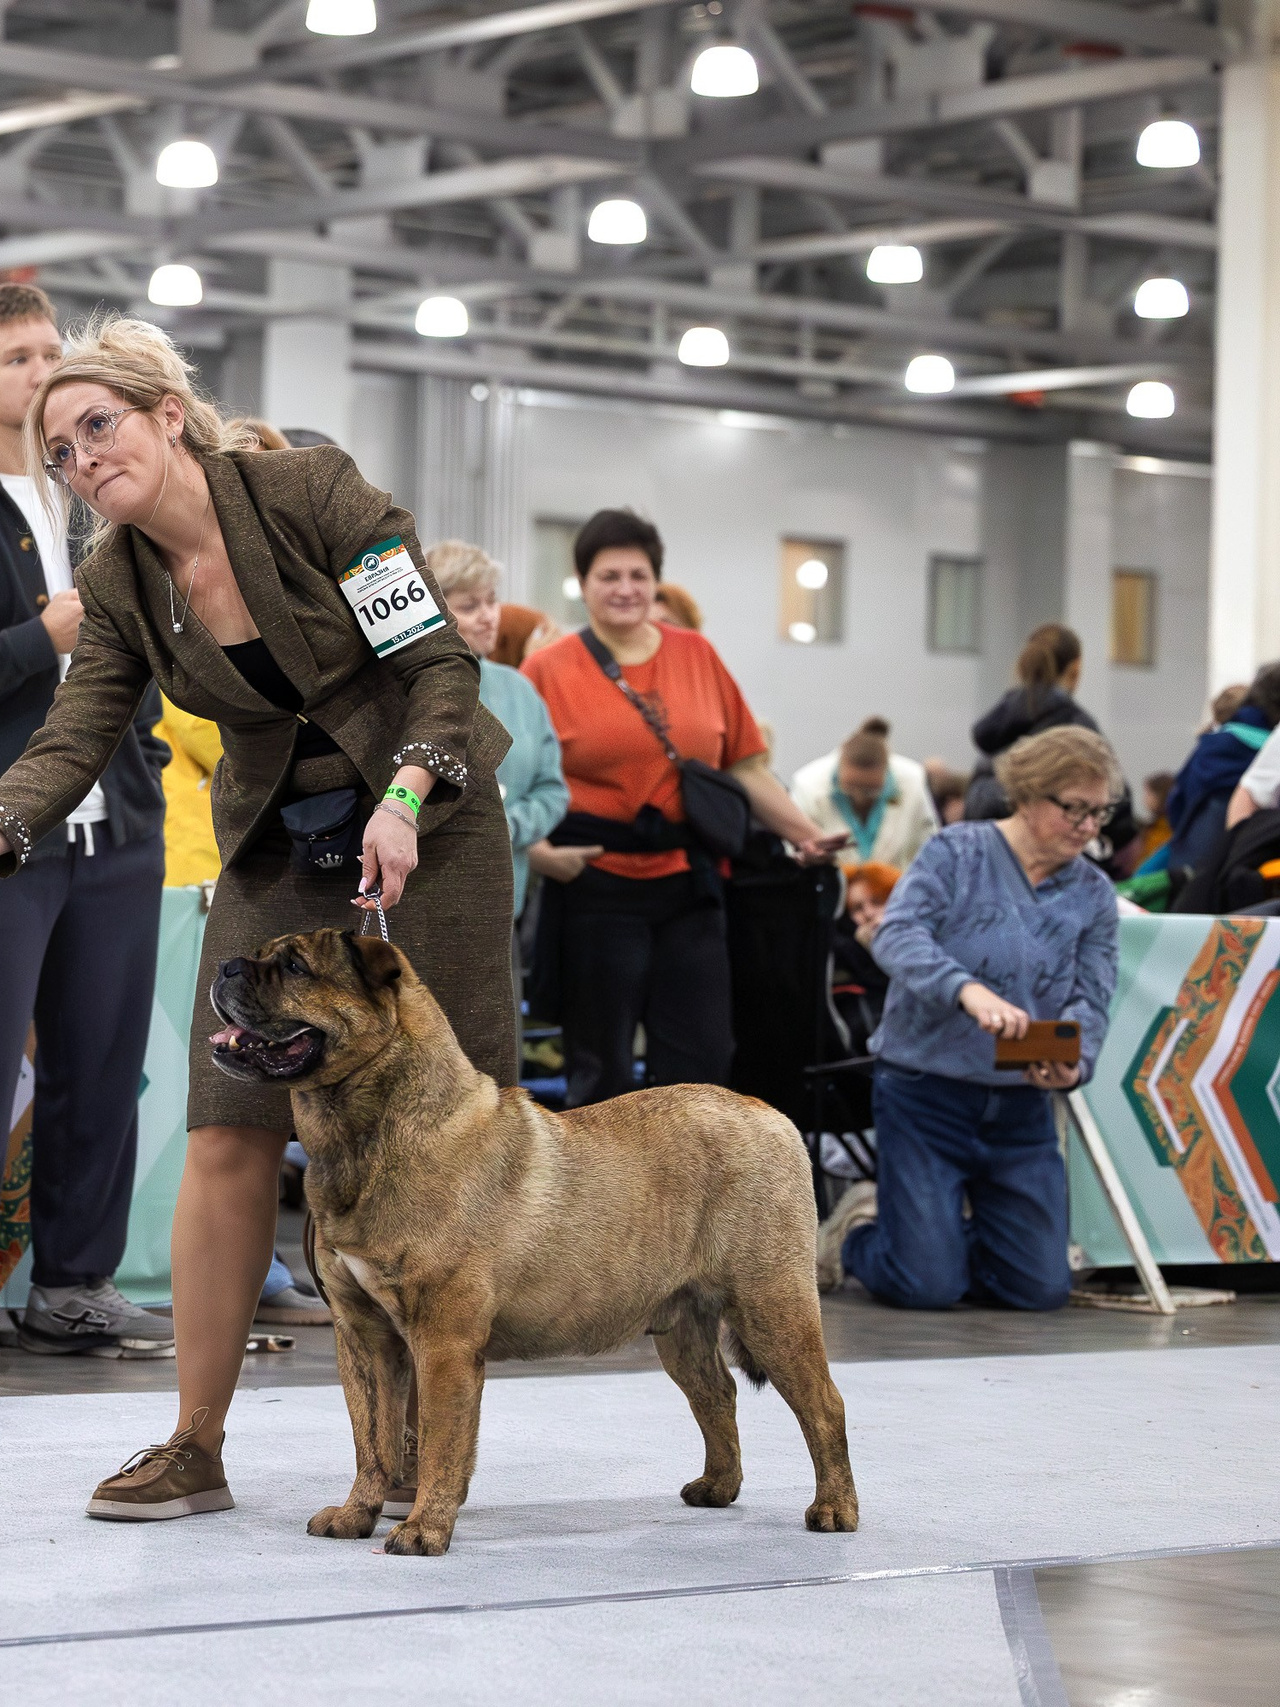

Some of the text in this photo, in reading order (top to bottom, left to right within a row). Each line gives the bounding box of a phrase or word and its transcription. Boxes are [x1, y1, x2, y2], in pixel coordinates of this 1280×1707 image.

[364, 566, 390, 583] ЕВРАЗИЯ
[359, 580, 425, 626] 1066
[391, 622, 425, 644] 15.11.2025
